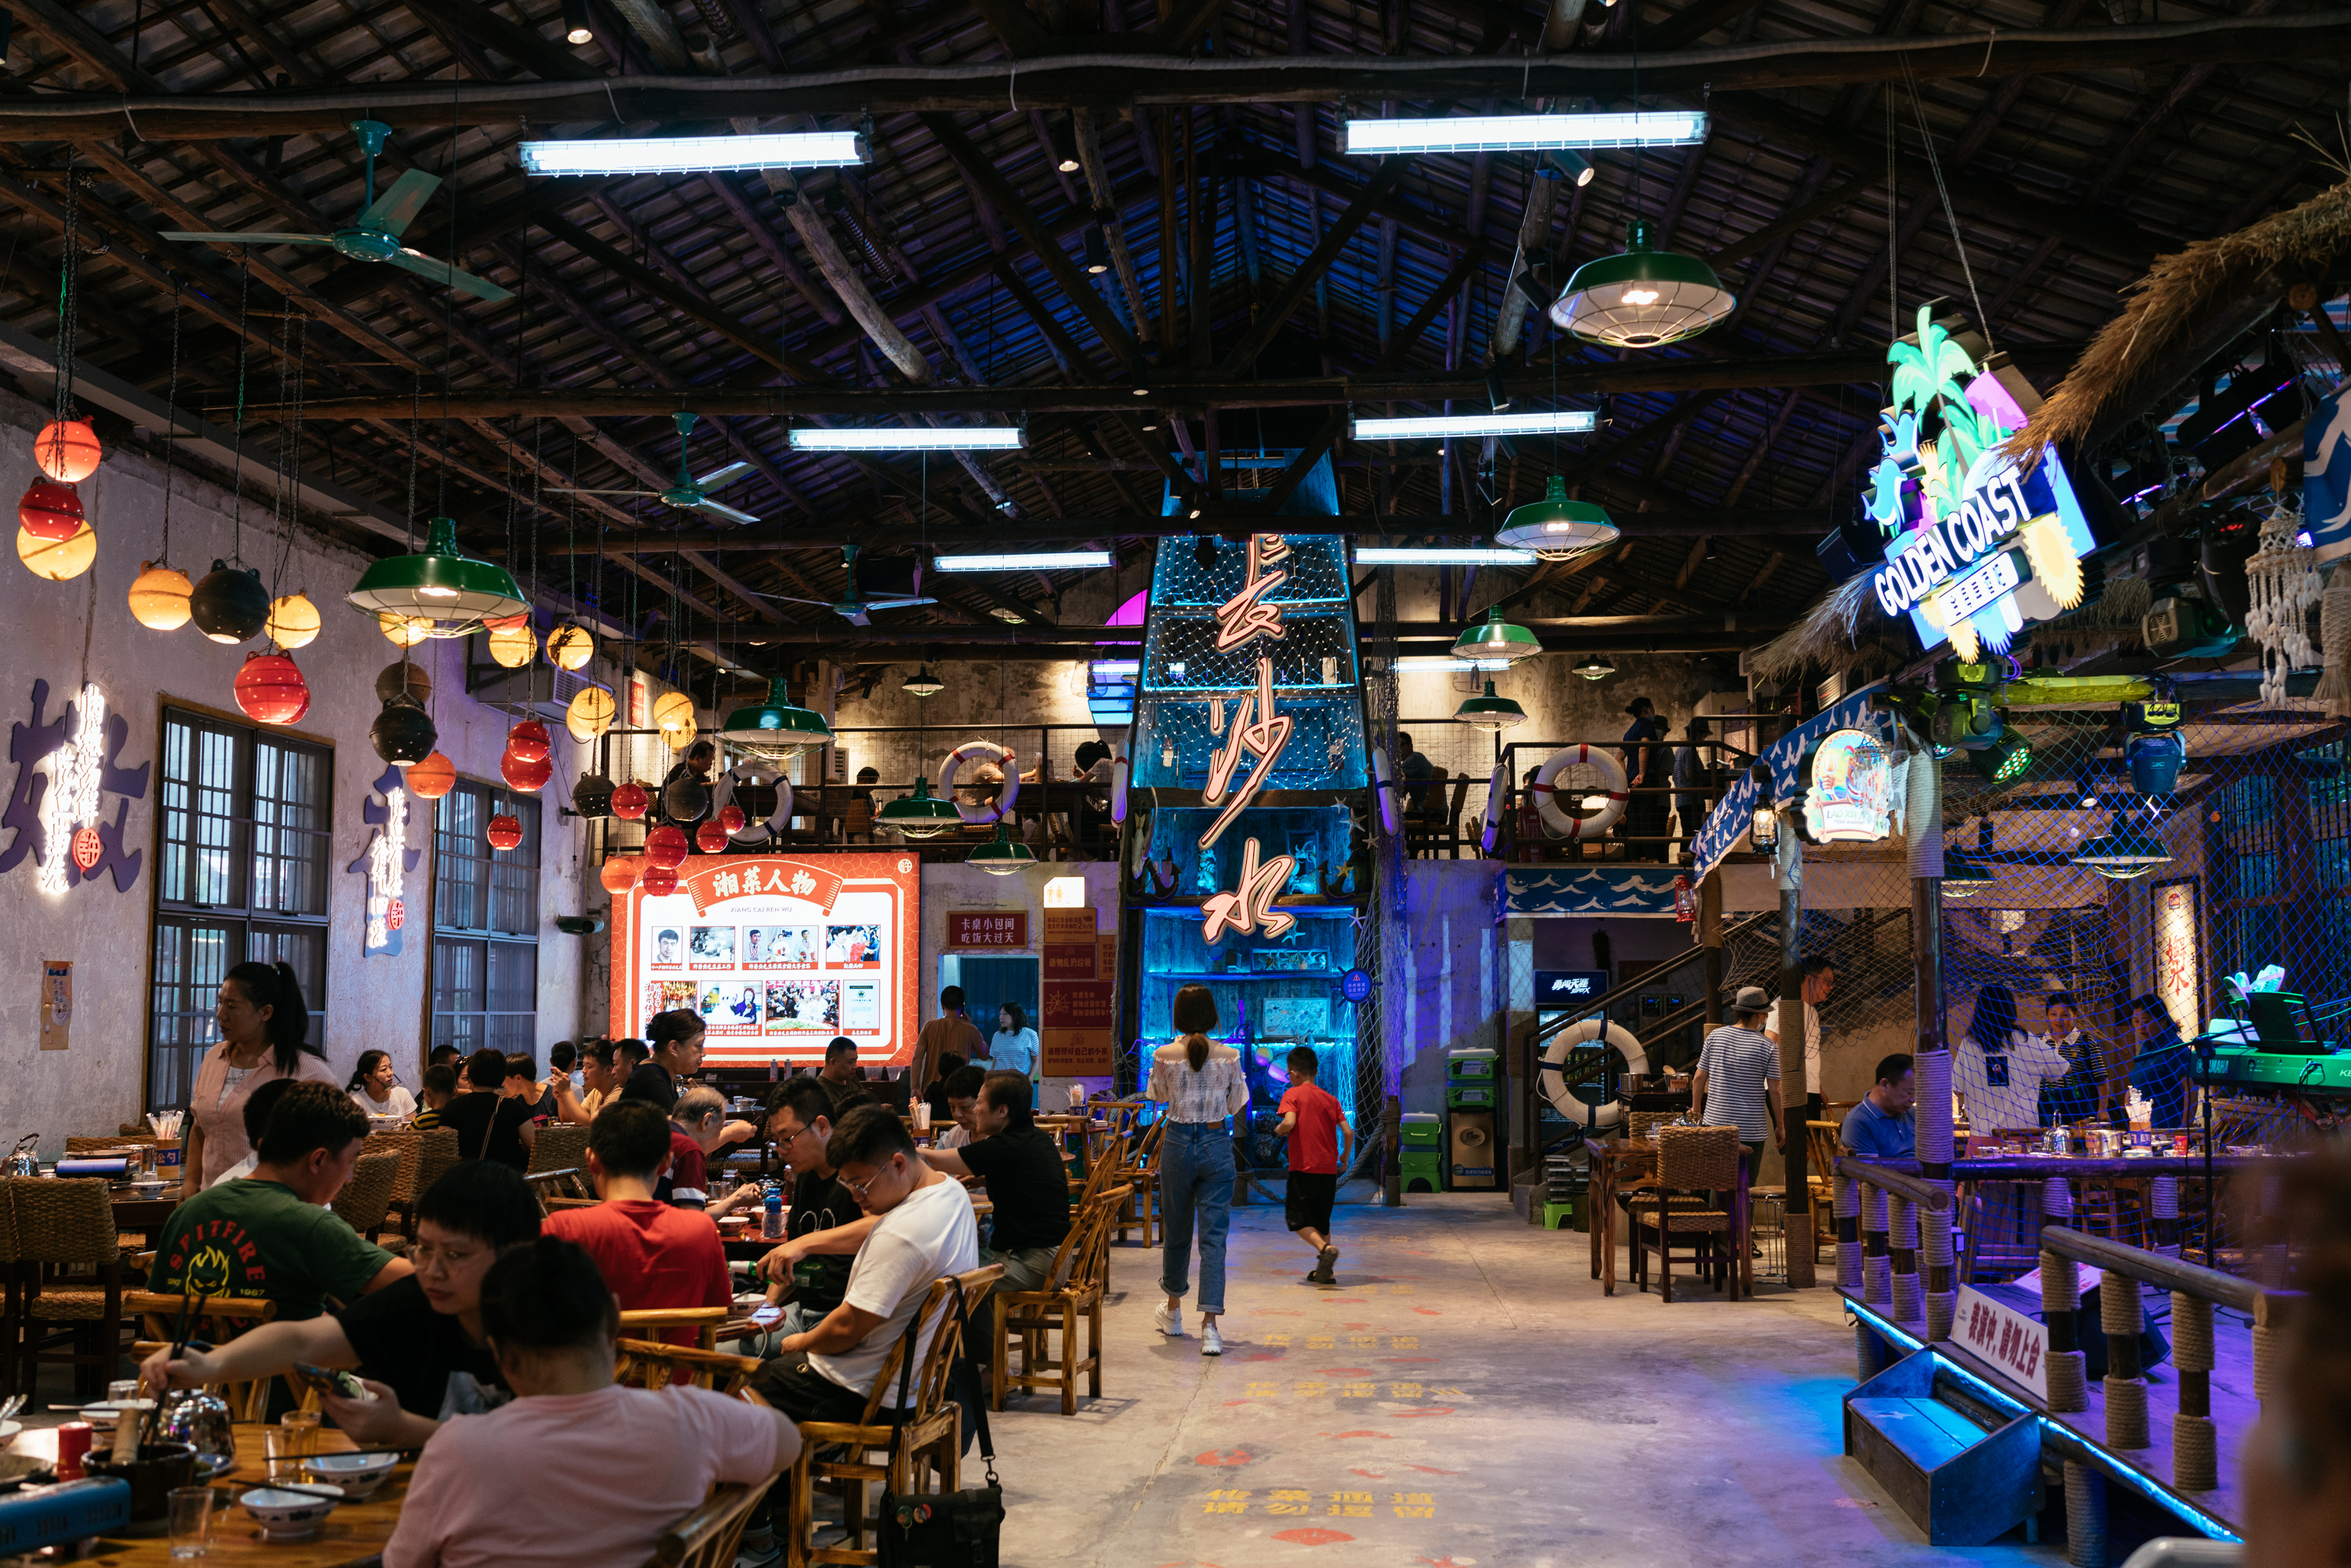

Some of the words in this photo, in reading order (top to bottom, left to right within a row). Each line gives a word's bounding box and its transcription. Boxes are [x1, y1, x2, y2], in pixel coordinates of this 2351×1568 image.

[1875, 523, 1958, 617] GOLDEN
[1947, 465, 2032, 563] COAST
[712, 866, 817, 897] 湘菜人物
[961, 918, 1015, 930] 卡桌小包间
[961, 932, 1014, 943] 吃饭大过天
[1049, 958, 1092, 968] 请勿乱扔垃圾
[1552, 978, 1589, 990] 勇闯天涯
[1048, 1047, 1108, 1056] 请照顾好自己的小孩
[158, 1152, 176, 1164] 公勺
[169, 1219, 266, 1282] SPITFIRE
[240, 1287, 265, 1296] 1987
[1205, 1489, 1436, 1505] 传菜通道
[1201, 1502, 1435, 1518] 请勿逗留
